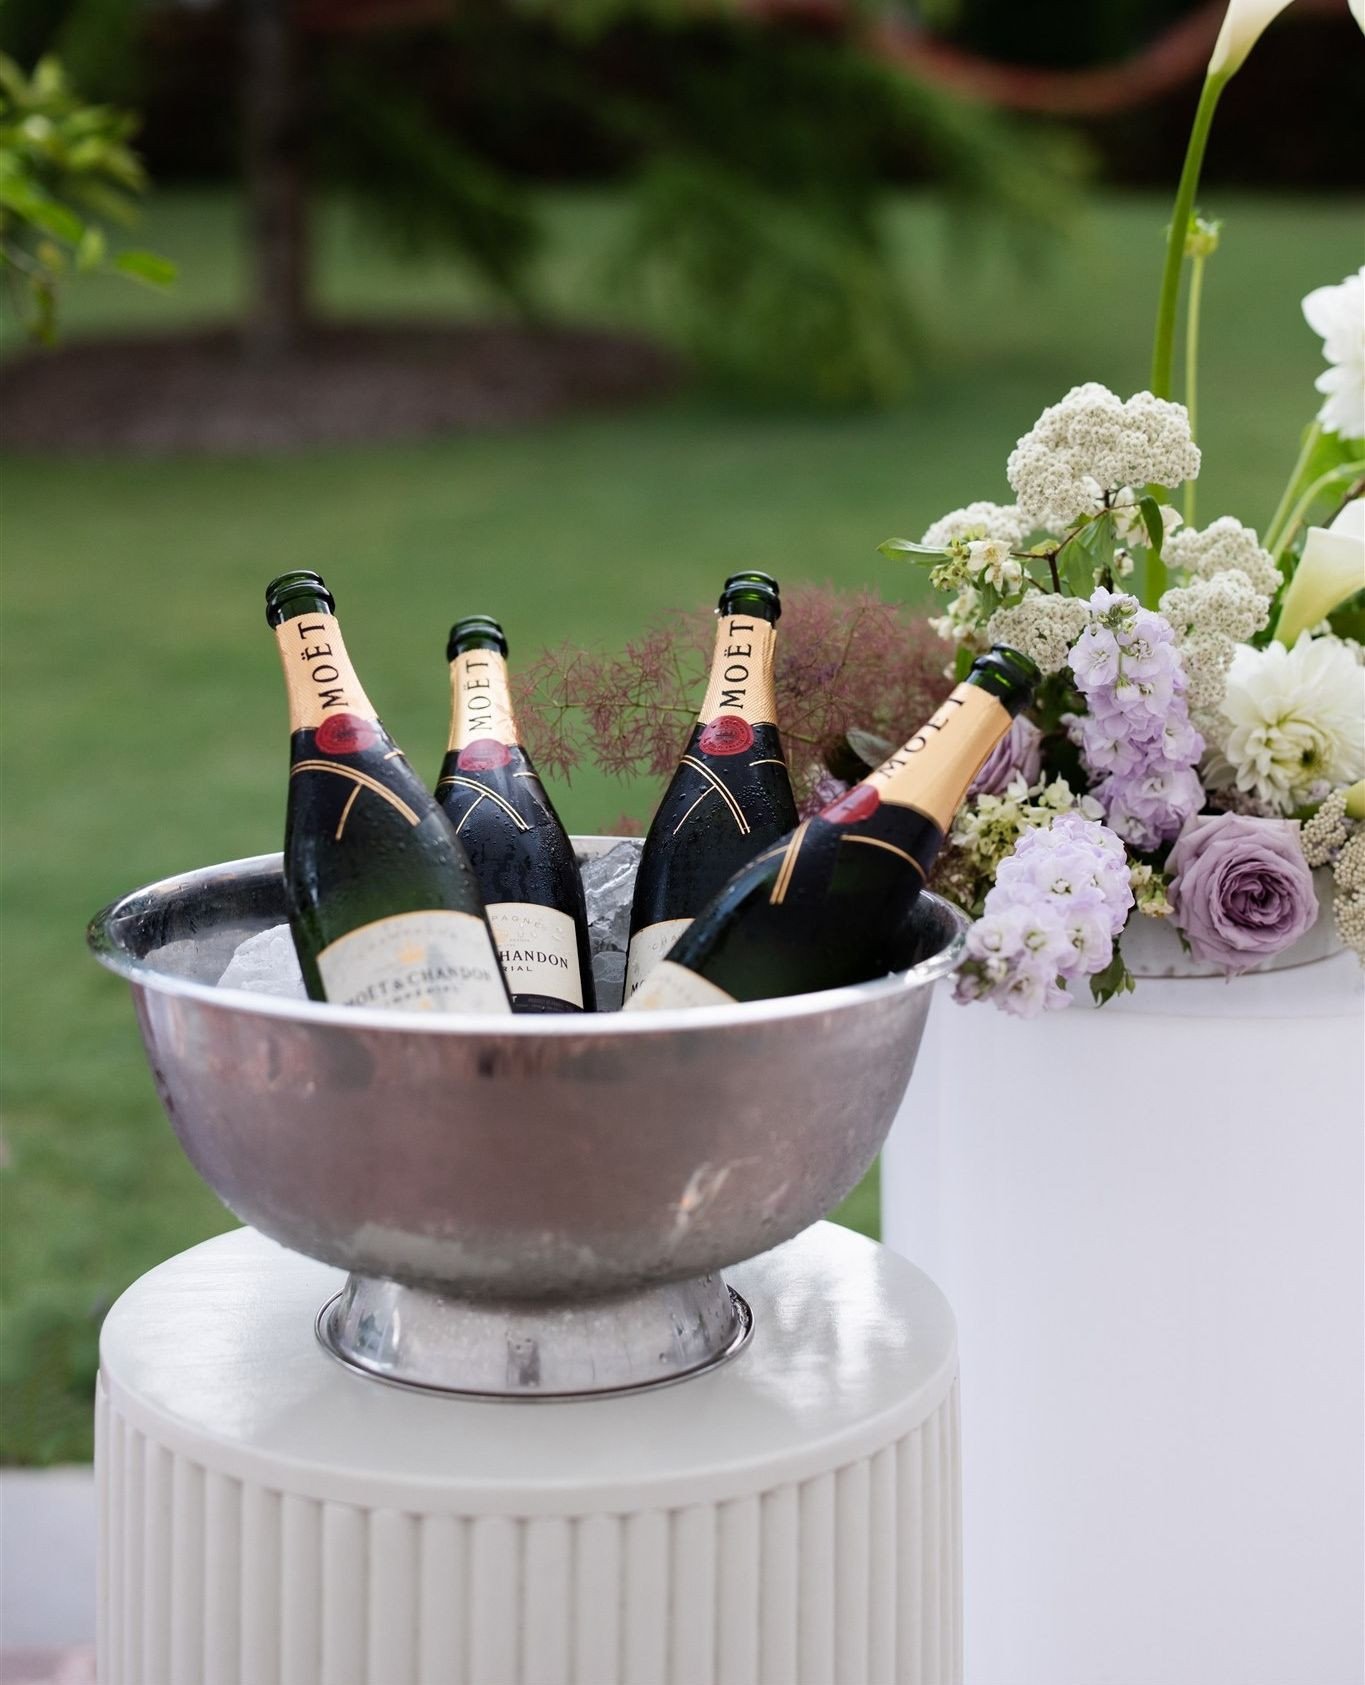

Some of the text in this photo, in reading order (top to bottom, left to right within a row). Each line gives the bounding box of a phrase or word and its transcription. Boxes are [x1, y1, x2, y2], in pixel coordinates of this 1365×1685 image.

[298, 621, 349, 709] MOËT
[719, 619, 754, 709] MOËT
[491, 914, 543, 928] PAGNE
[499, 949, 569, 969] HANDON
